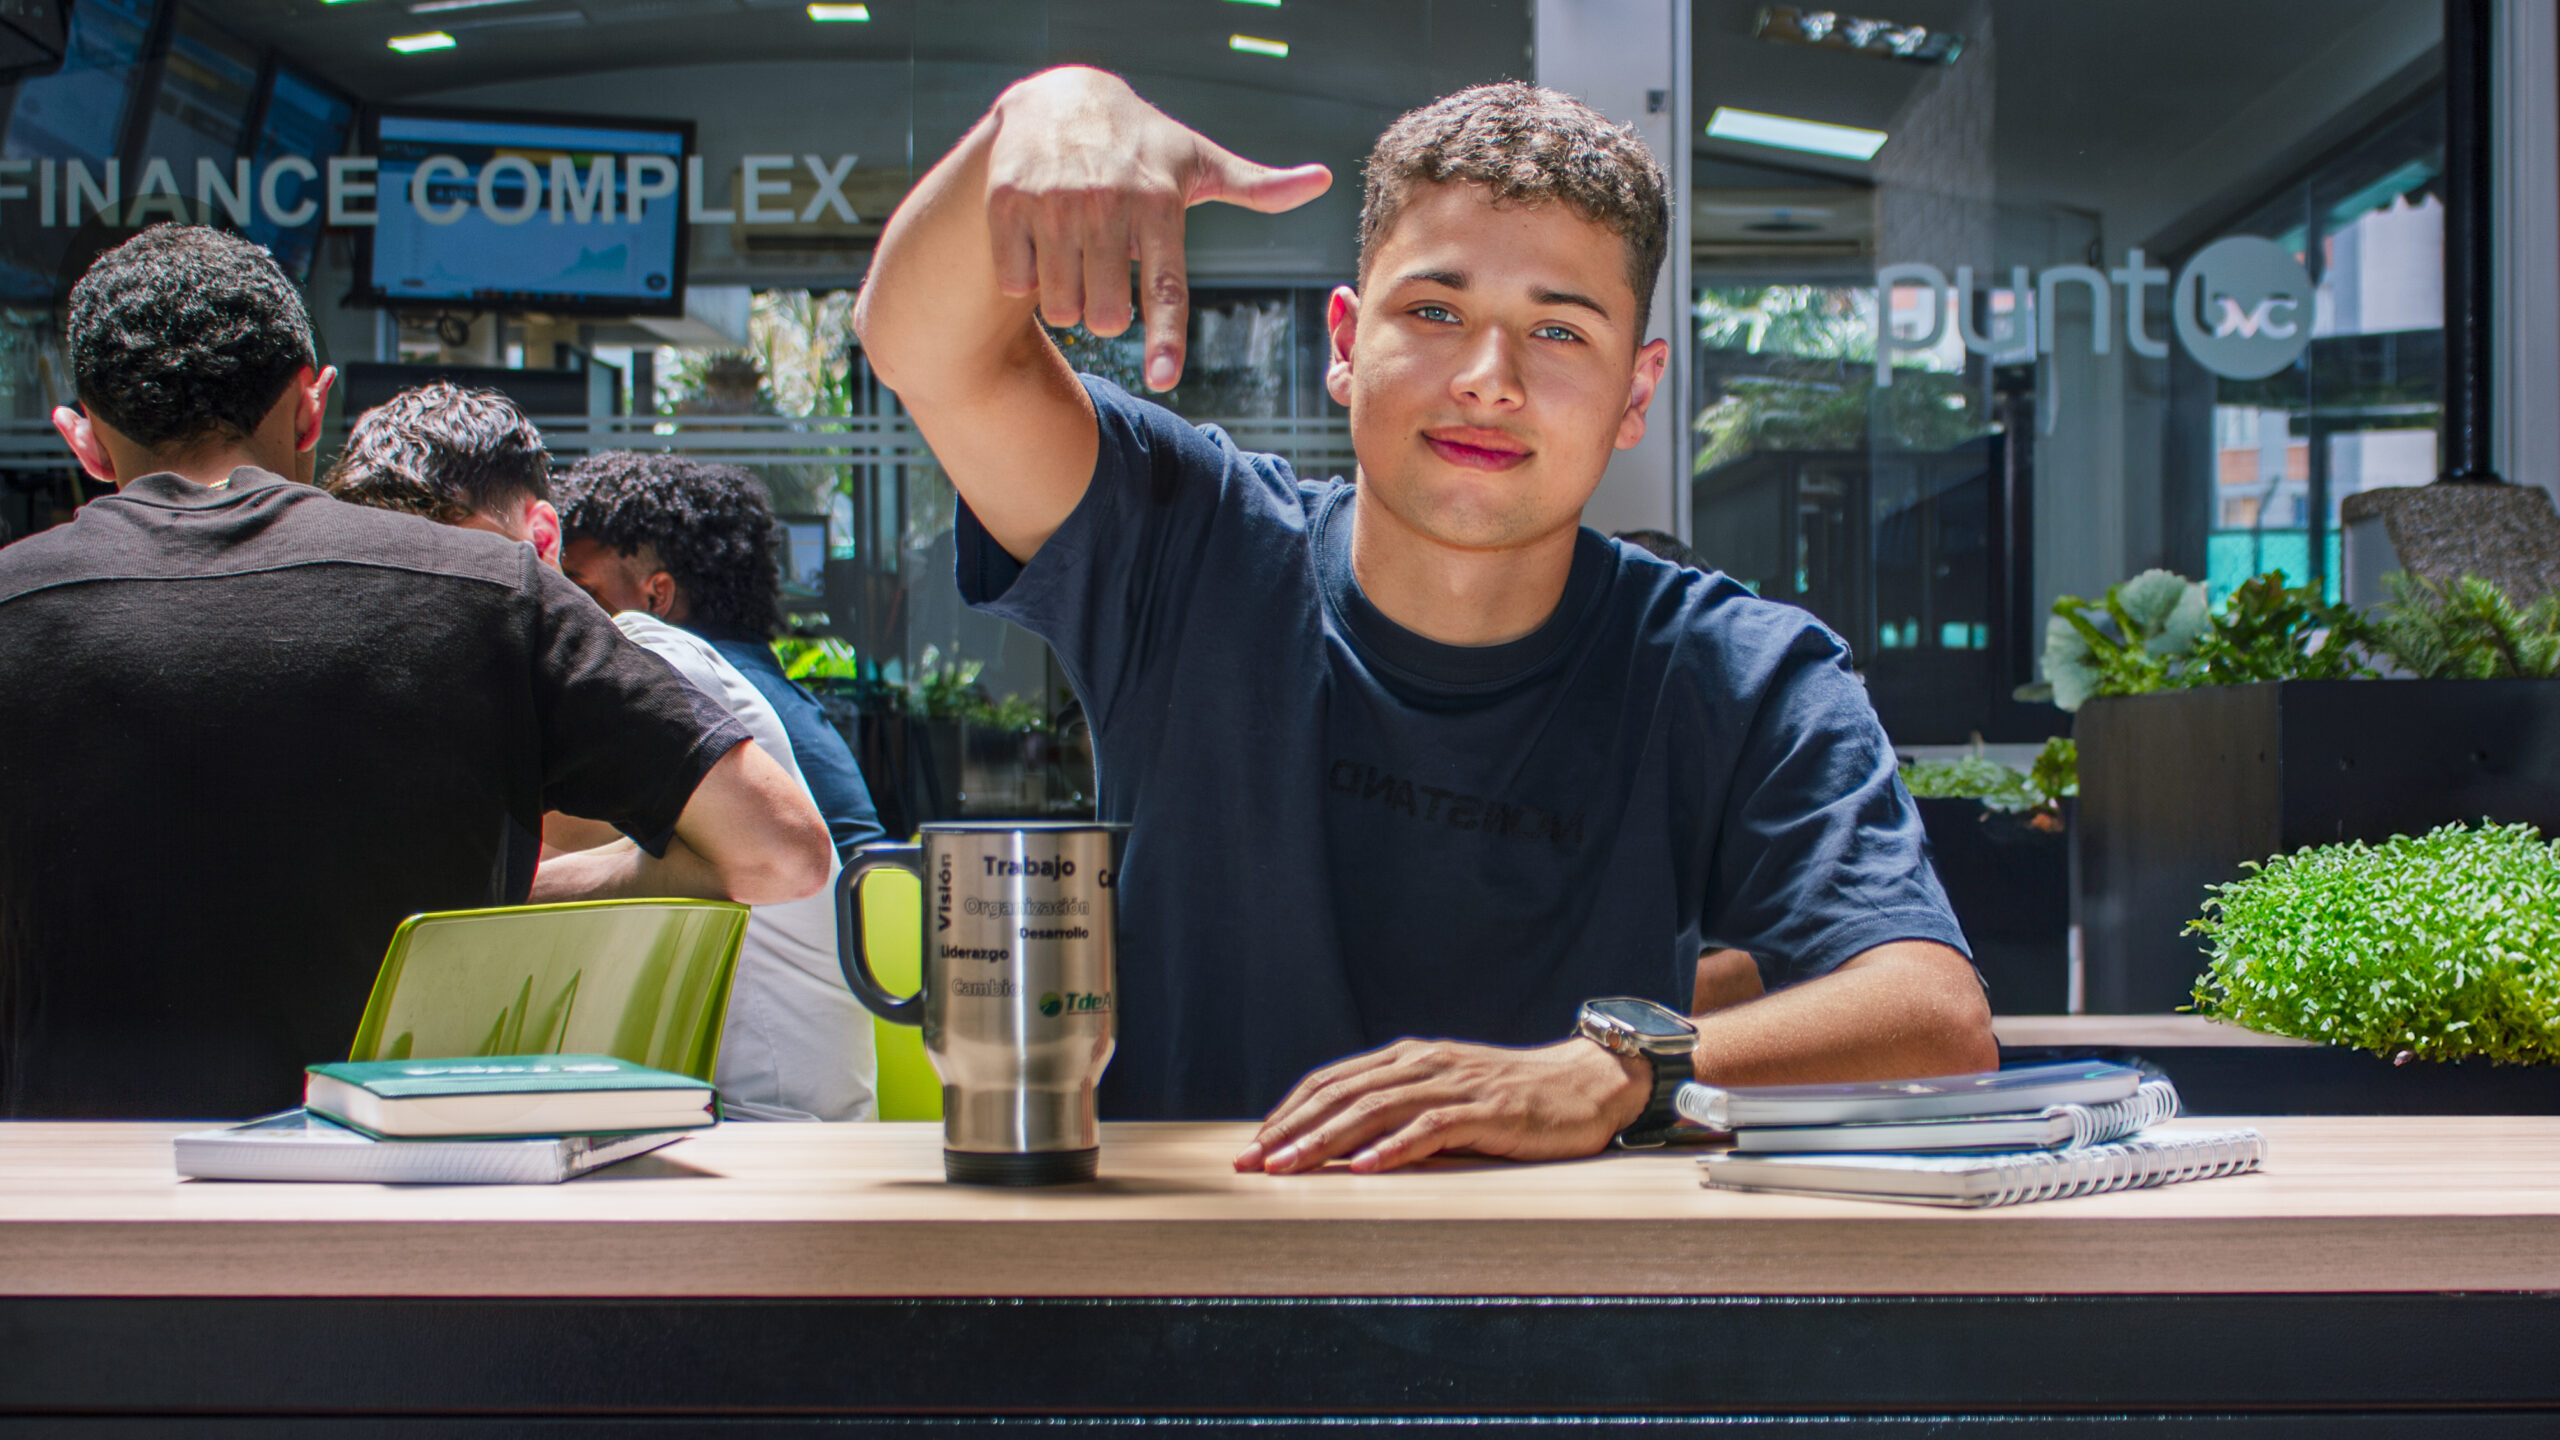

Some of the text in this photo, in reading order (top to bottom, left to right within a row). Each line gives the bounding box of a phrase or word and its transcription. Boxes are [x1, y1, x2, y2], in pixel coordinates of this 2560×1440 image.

[411, 154, 861, 226] COMPLEX
[982, 855, 1076, 881] Trabajo
[938, 853, 952, 932] Visión
[1019, 926, 1089, 940] Desarrollo
[940, 944, 1010, 963] Liderazgo
[951, 977, 1023, 998] Cambio
